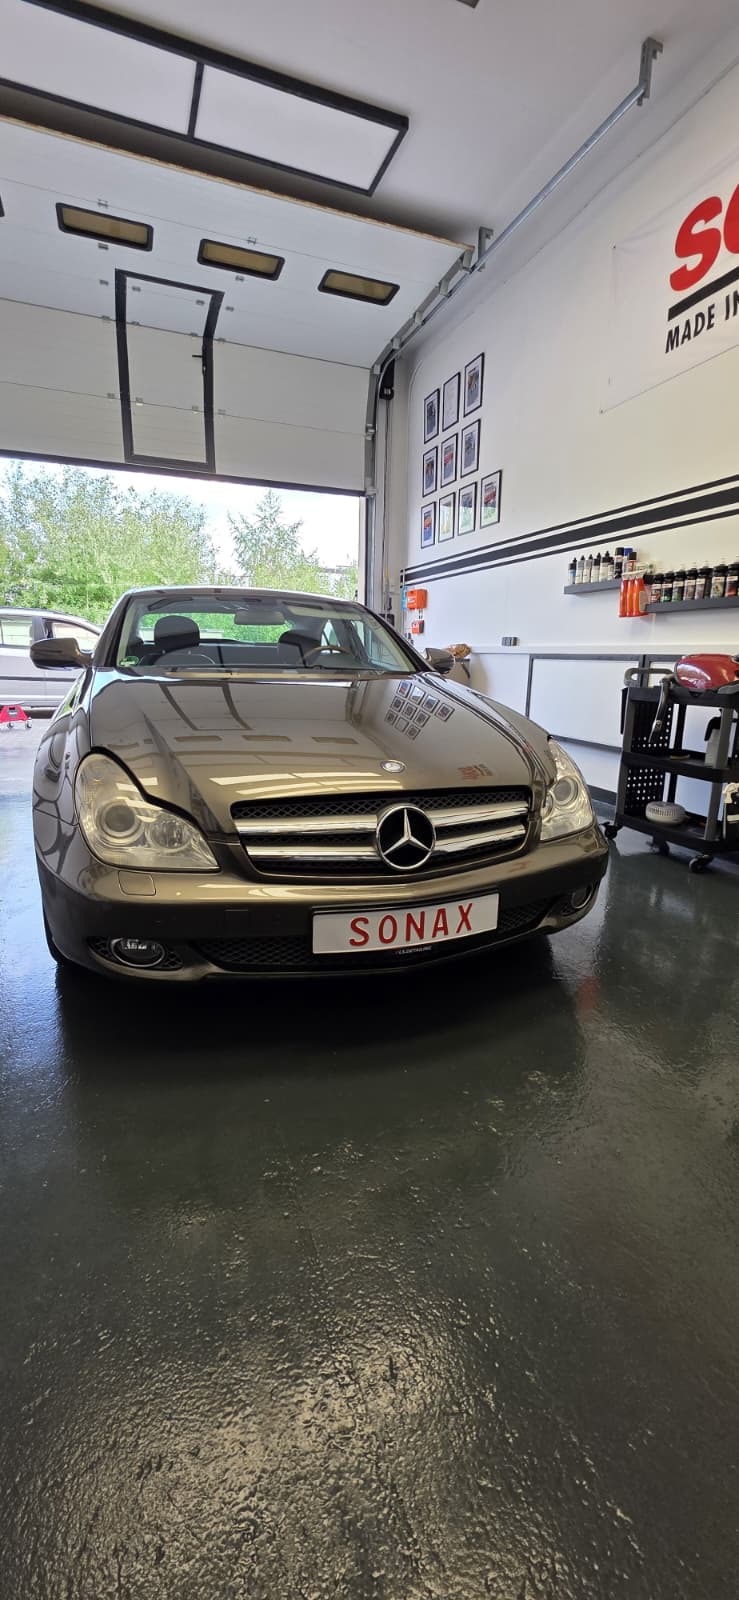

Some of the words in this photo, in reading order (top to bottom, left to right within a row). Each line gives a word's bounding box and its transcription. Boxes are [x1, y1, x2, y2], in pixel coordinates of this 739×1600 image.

[669, 184, 739, 292] S
[665, 303, 716, 354] MADE
[348, 902, 473, 947] SONAX
